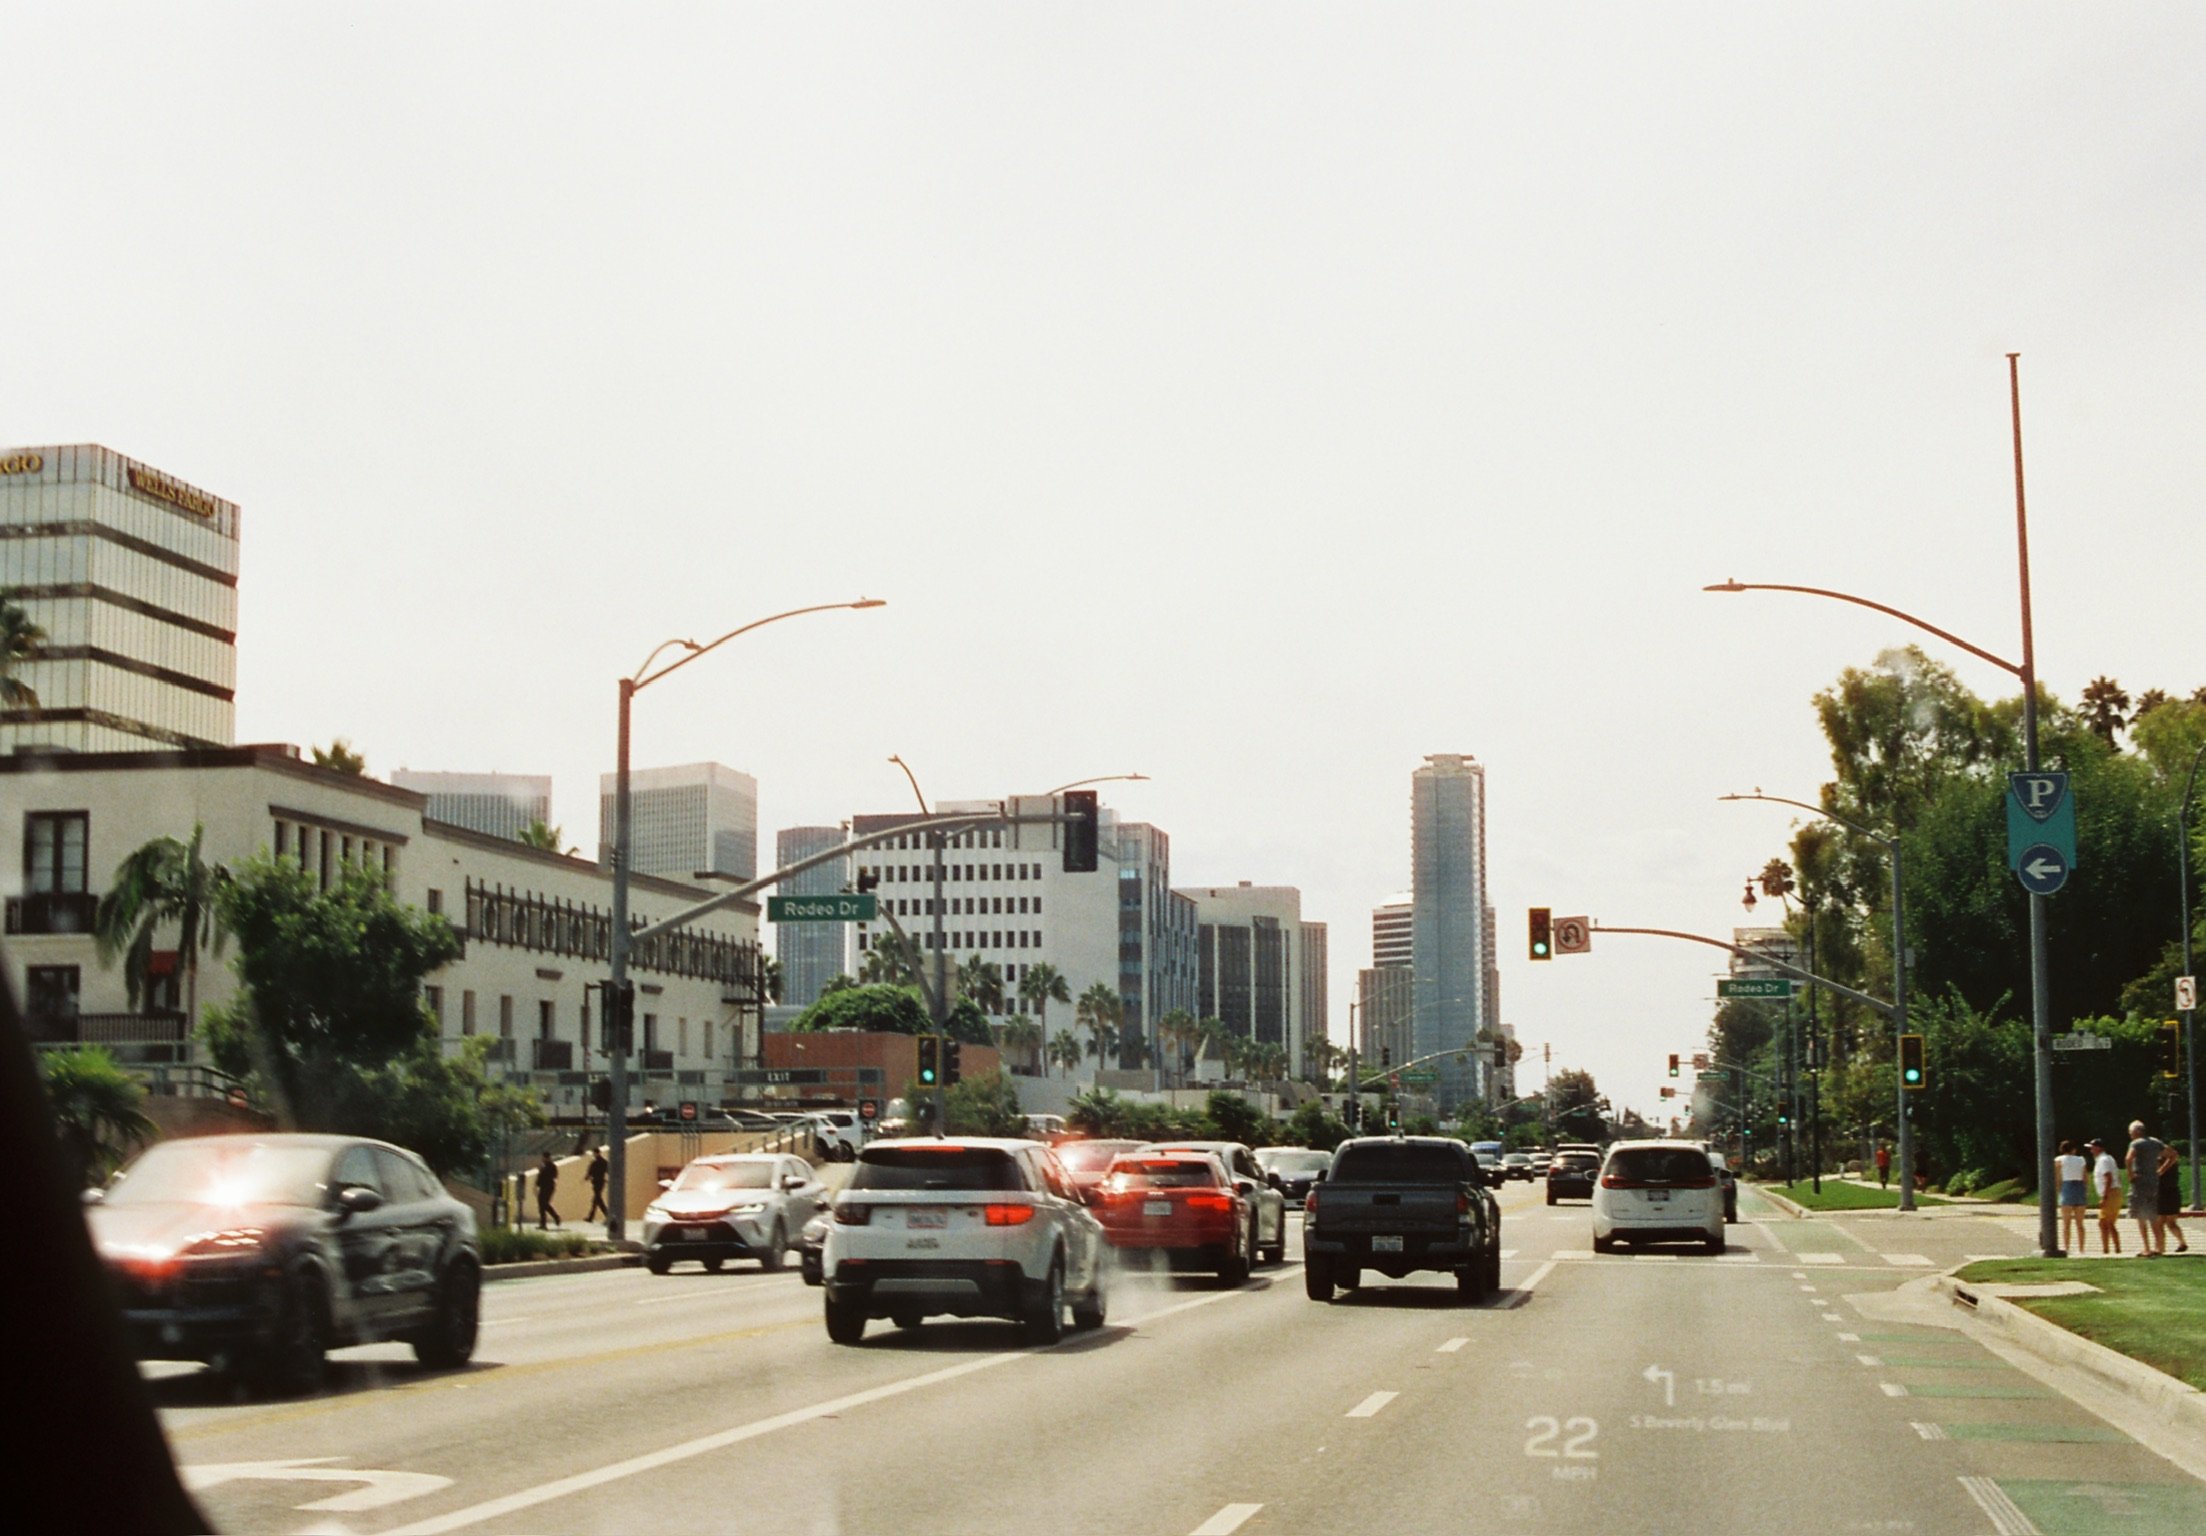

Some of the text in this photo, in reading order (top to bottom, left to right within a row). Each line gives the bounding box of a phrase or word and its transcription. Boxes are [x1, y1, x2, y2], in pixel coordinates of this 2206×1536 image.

[0, 454, 43, 476] GO
[134, 470, 177, 502] WELLS
[2027, 779, 2055, 808] P
[784, 900, 859, 916] Rodeo Dr
[1728, 983, 1779, 994] Rodeo Dr
[767, 1071, 790, 1082] EXIT
[1524, 1415, 1600, 1458] 22
